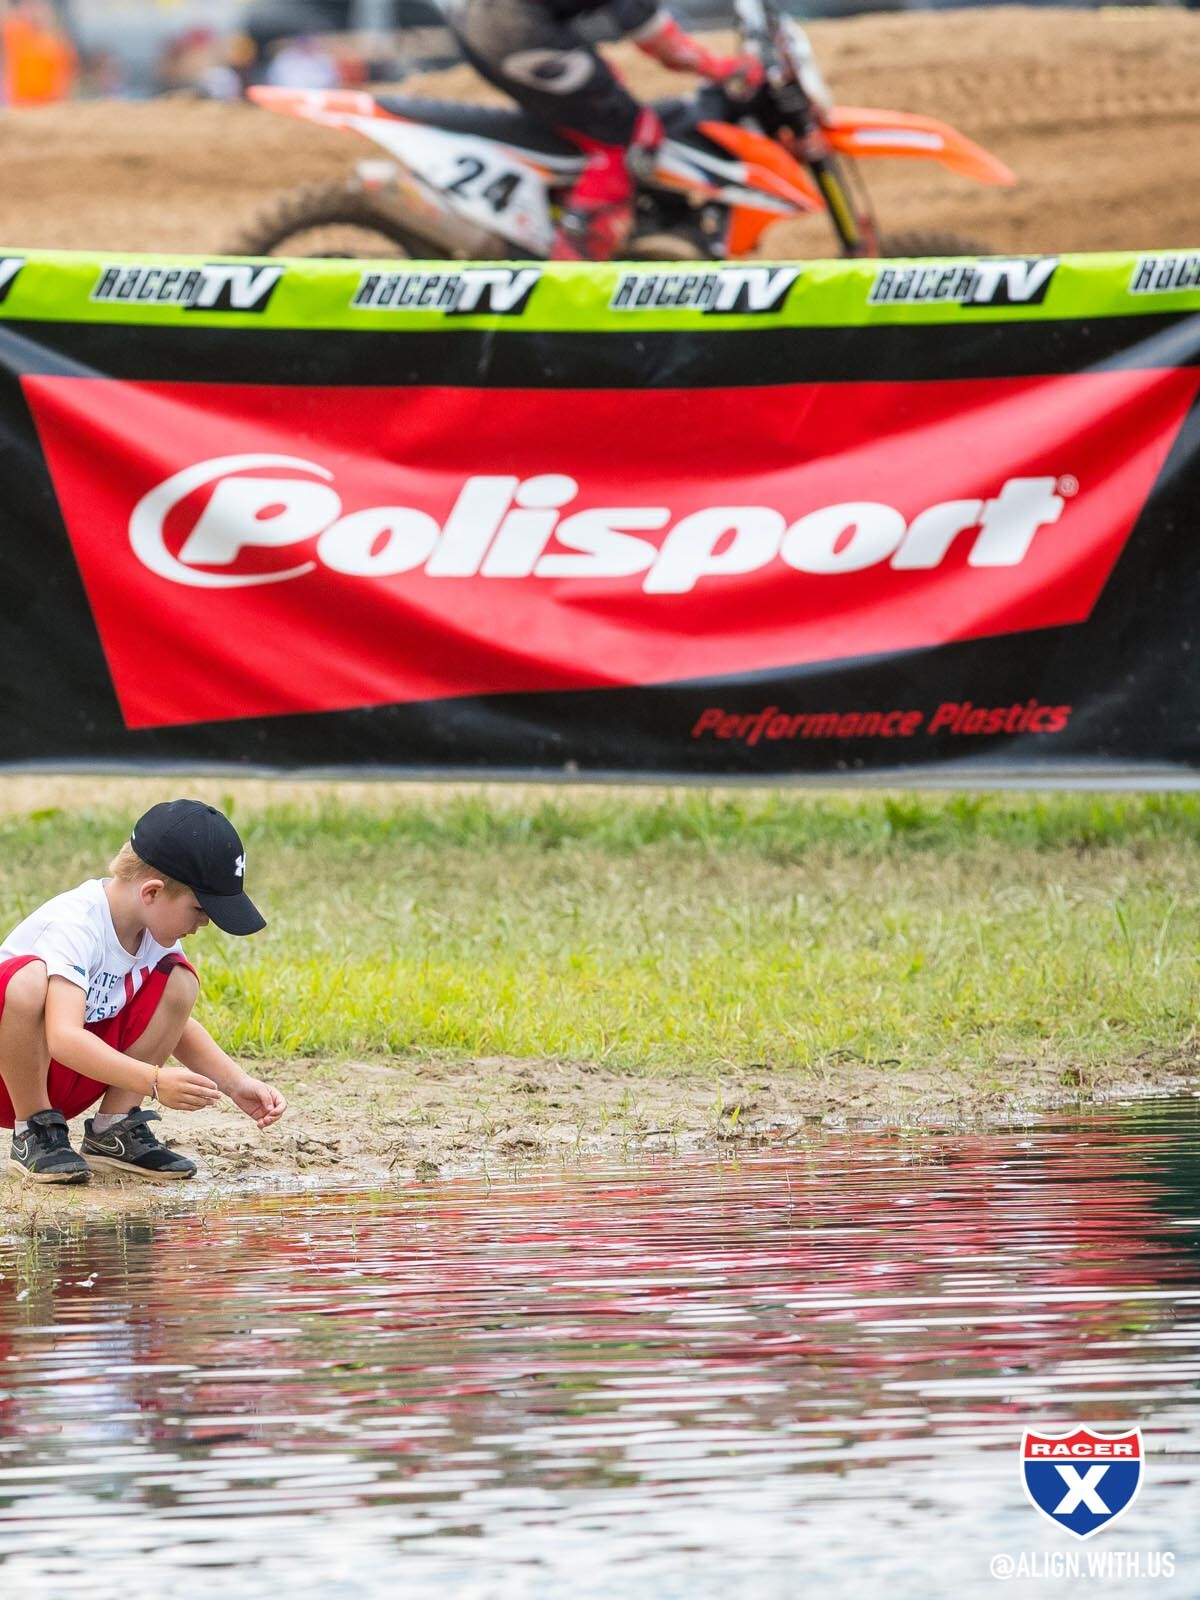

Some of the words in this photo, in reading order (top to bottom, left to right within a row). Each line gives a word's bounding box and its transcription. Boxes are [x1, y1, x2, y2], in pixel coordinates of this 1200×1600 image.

[447, 155, 522, 214] 24
[130, 454, 1066, 594] Polisport
[692, 704, 923, 746] Performance
[926, 698, 1072, 735] Plastics
